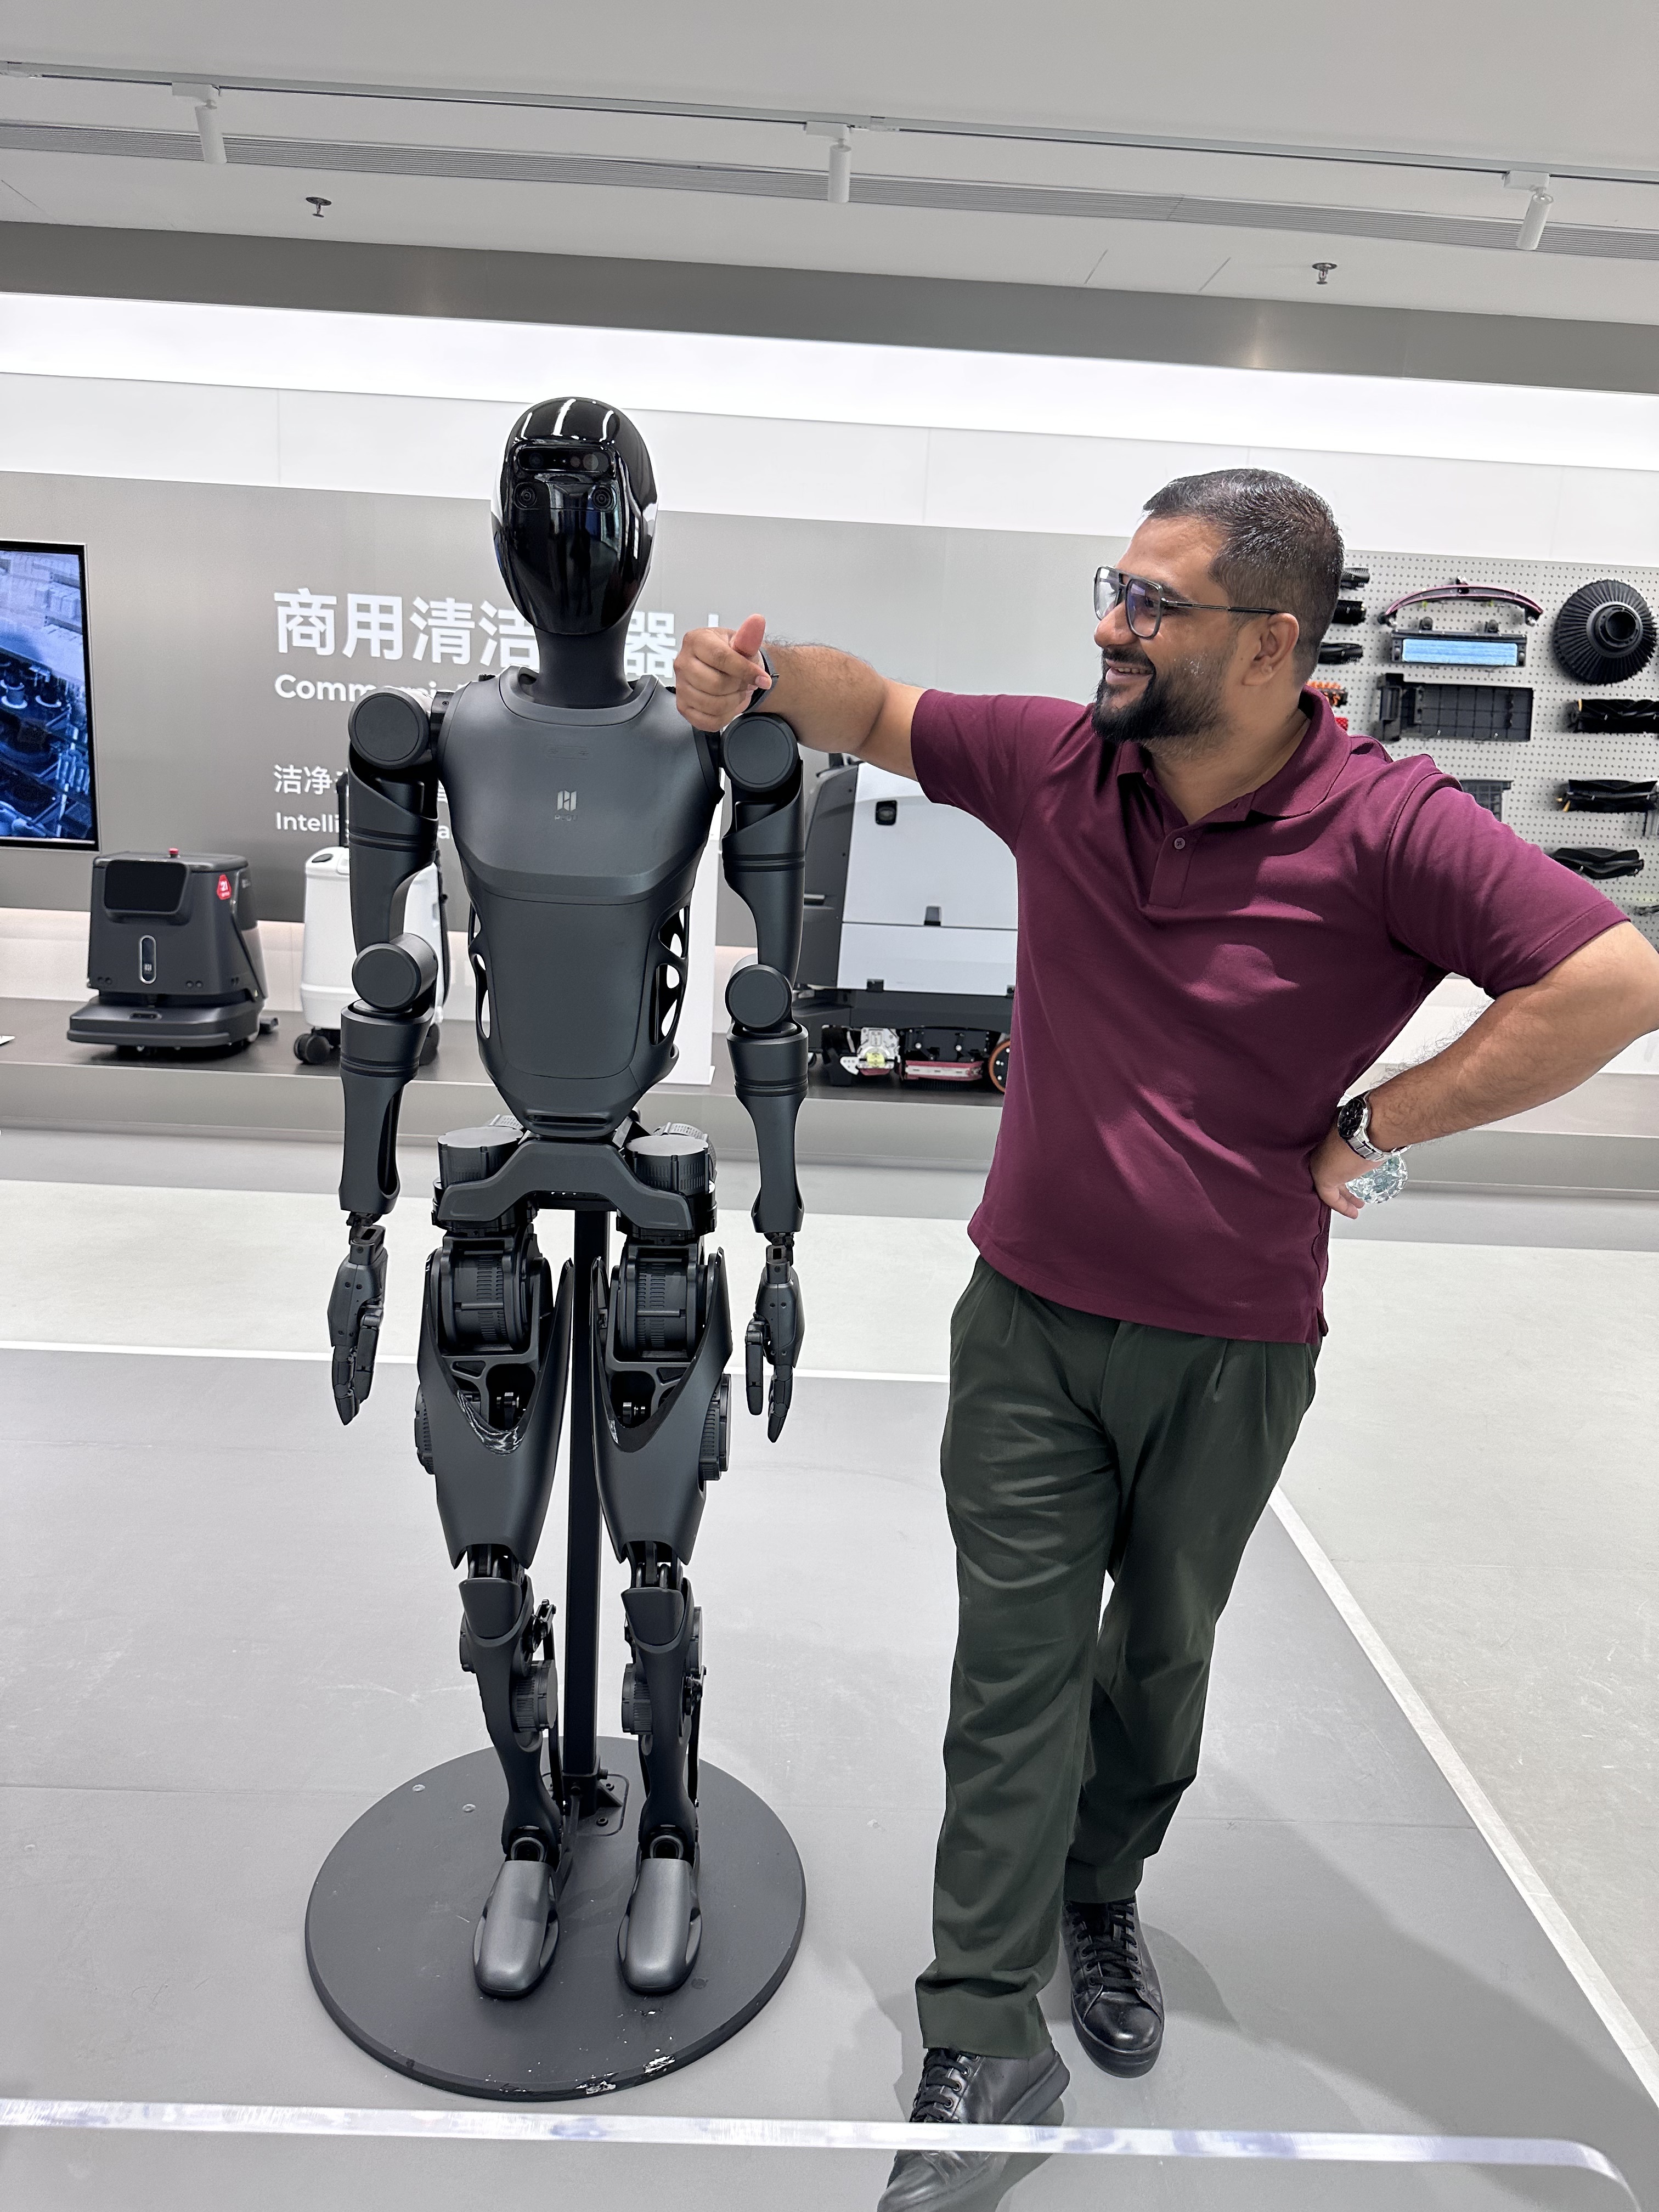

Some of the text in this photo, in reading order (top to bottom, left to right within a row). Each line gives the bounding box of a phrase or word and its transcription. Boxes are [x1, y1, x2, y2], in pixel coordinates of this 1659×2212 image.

[274, 588, 719, 679] 商用清洁器
[273, 764, 349, 795] 洁净
[276, 812, 349, 837] Intelli
